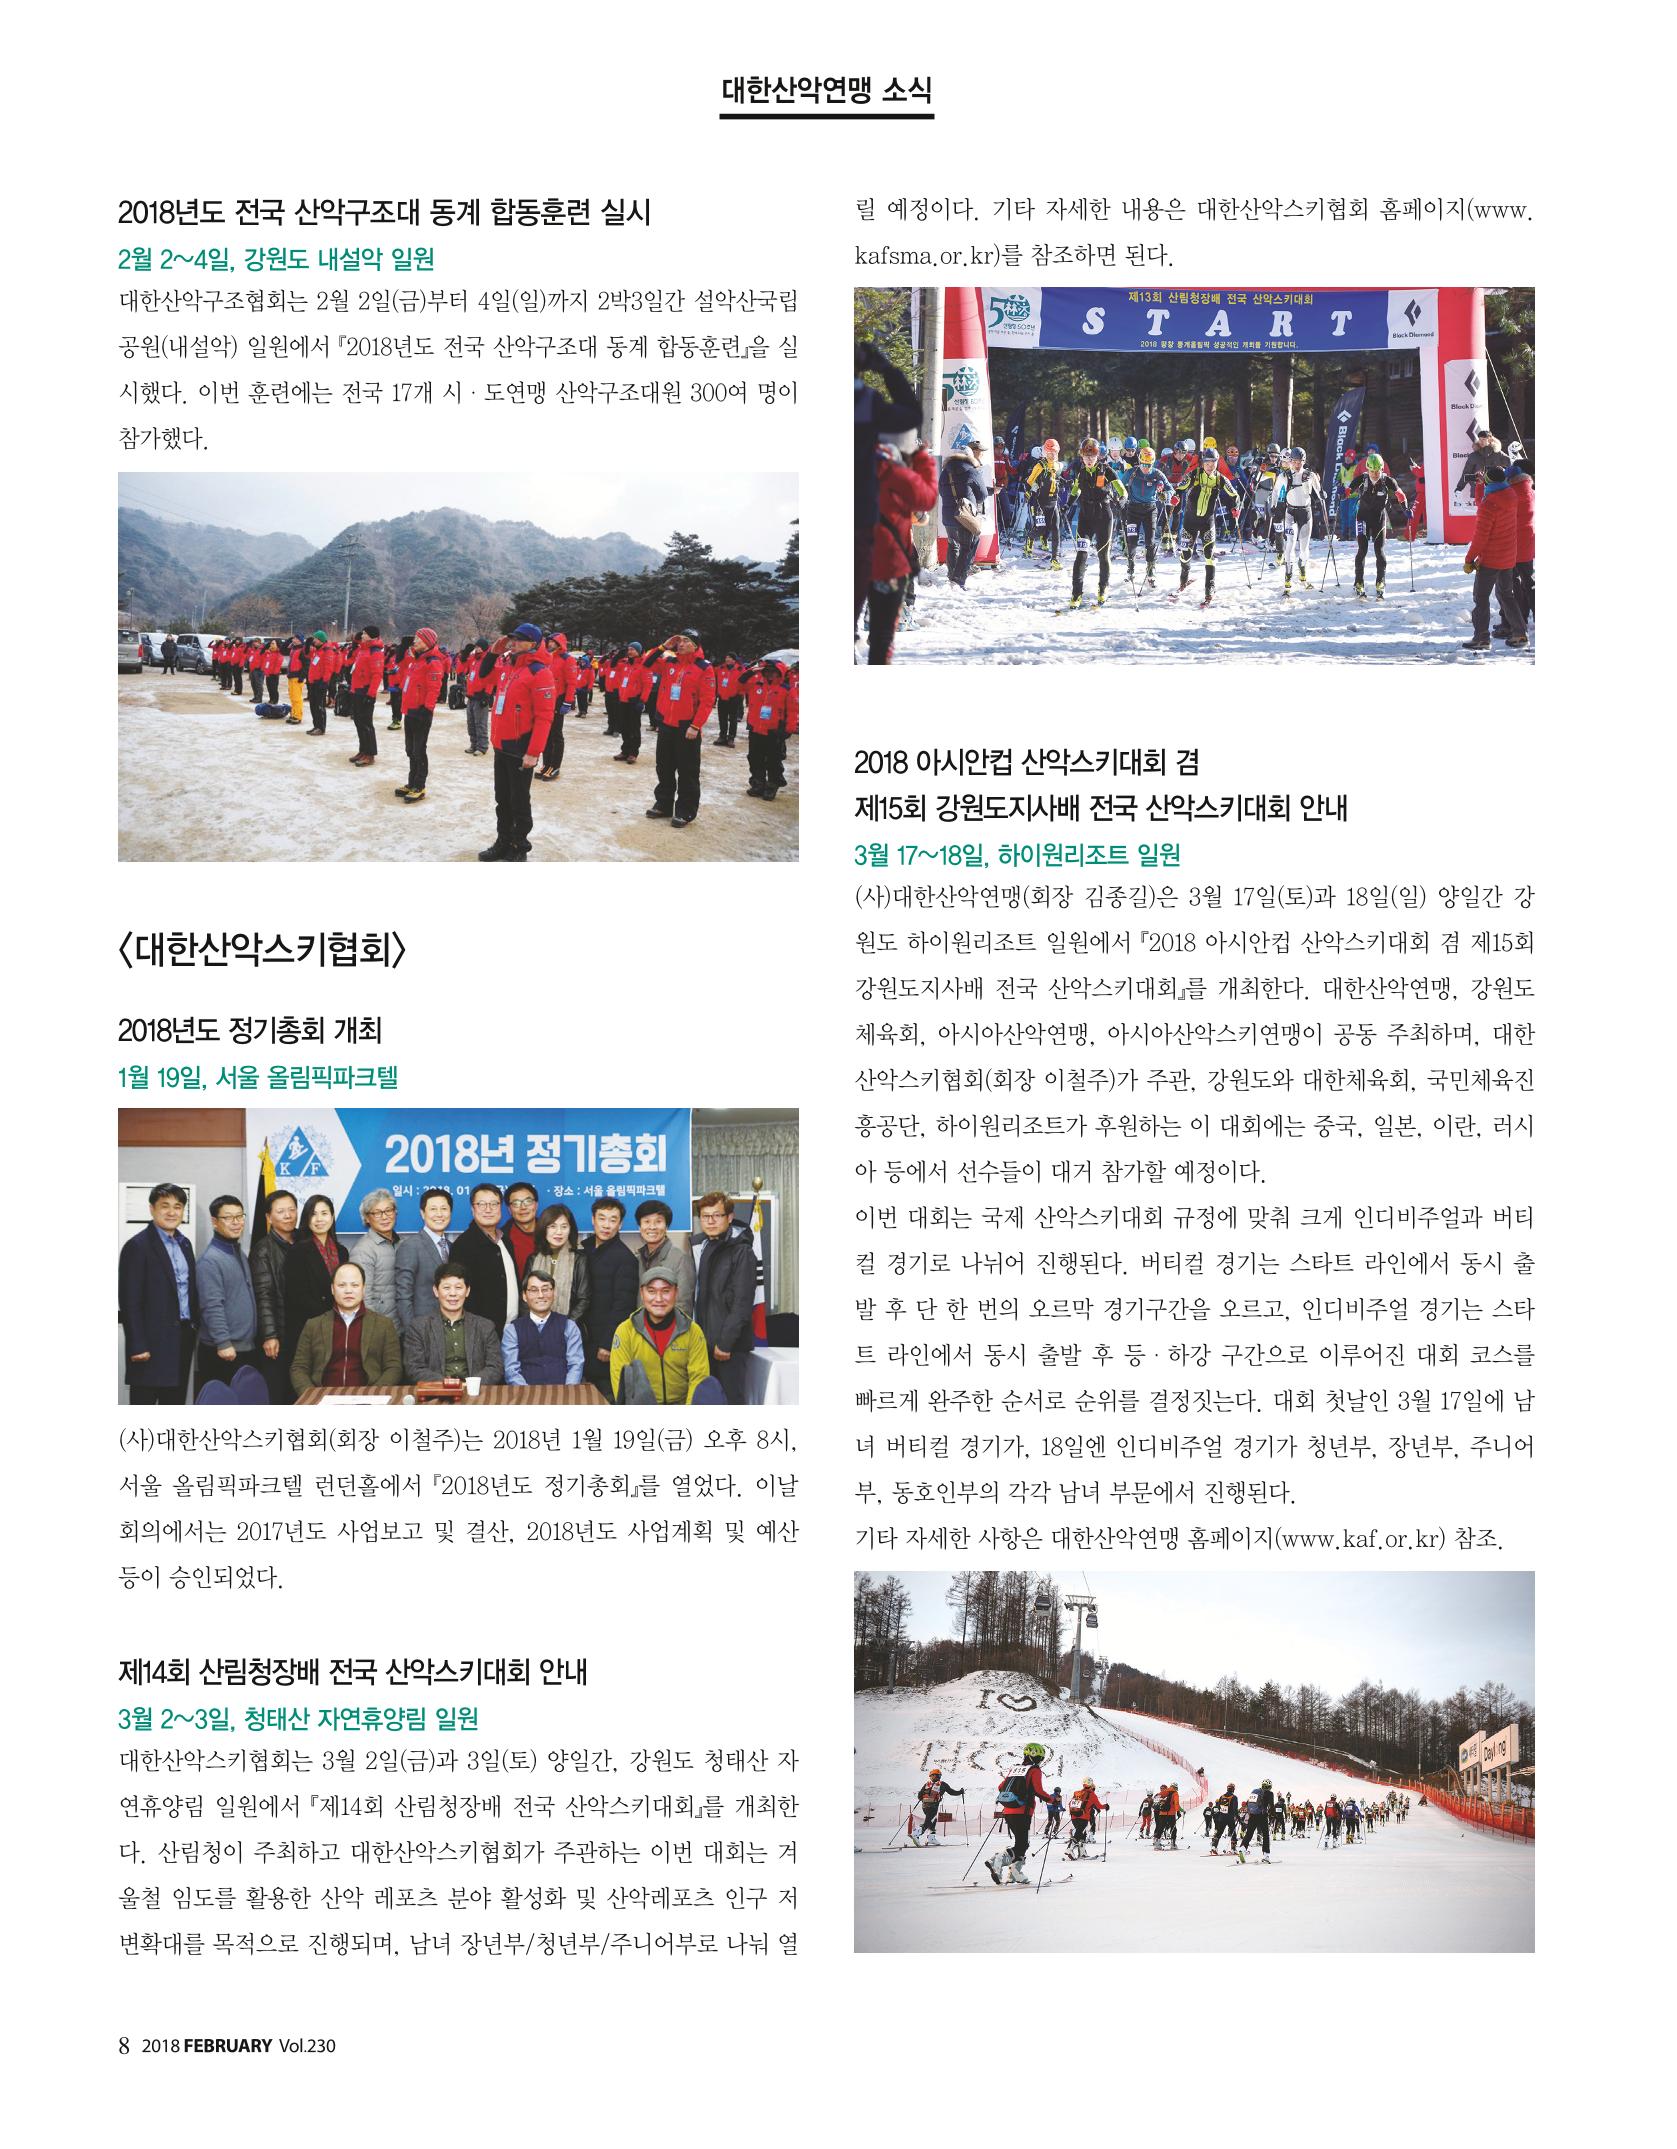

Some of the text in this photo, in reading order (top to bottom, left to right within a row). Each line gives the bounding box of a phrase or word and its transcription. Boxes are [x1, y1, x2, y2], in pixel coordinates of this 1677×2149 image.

[722, 75, 932, 105] 대한산악연맹 소식
[117, 197, 650, 227] 2018년도 전국 산악구조대 동계 합동훈련 실시
[856, 197, 1532, 222] 릴 예정이다. 기타 자세한 내용은 대한산악스키협회 홈페이지(www.
[117, 246, 152, 272] 2월
[244, 246, 310, 273] 강원도
[318, 247, 384, 272] 내설악
[391, 246, 434, 272] 일원
[854, 242, 1173, 268] kafsma.or.kr)를 참조하면 된다.
[119, 288, 797, 314] 대한산악구조협회는 2월 2일(금)부터 4일(일)까지 2박3일간 설악산국립
[1128, 291, 1314, 305] 제13회 산림청장배 전국 산악스키대회
[1082, 306, 1353, 338] START
[119, 426, 208, 451] 참가했다.
[1335, 425, 1348, 460] Black
[854, 747, 1199, 777] 2018 아시안컵 산악스키대회 겸
[854, 793, 1348, 823] 제15회 강원도지사배 전국 산악스키대회 안내
[854, 842, 889, 868] 3월
[997, 842, 1130, 868] 하이원리조트
[1137, 842, 1181, 868] 일원
[855, 884, 1536, 910] (사)대한산악연맹(회장 김종길)은 3월 17일(토)과 18일(일) 양일간 강
[117, 1015, 382, 1045] 2018년도 정기총회 개최
[855, 1022, 1536, 1048] 체육회, 아시아산악연맹, 아시아산악스키연맹이 공동 주최하며, 대한
[118, 1064, 398, 1092] 1월 19일, 서울 올림픽파크텔
[385, 1132, 668, 1175] 2018년 정기총회
[855, 1159, 1266, 1185] 아 등에서 선수들이 대거 참가할 예정이다.
[392, 1184, 413, 1198] 일시
[553, 1184, 575, 1198] 장소
[583, 1184, 605, 1198] 서울
[606, 1184, 666, 1198] 올림픽파크텔
[855, 1388, 1536, 1414] 빠르게 완주한 순서로 순위를 결정짓는다. 대회 첫날인 3월 17일에 남
[119, 1427, 796, 1453] (사)대한산악스키협회(회장 이철주)는 2018년 1월 19일(금) 오후 8시,
[856, 1526, 1503, 1551] 기타 자세한 사항은 대한산악연맹 홈페이지(www.kaf.or.kr) 참조.
[117, 1565, 283, 1590] 등이 승인되었다.
[118, 1657, 587, 1687] 제14회 산림청장배 전국 산악스키대회 안내
[117, 1706, 153, 1732] 3월
[244, 1706, 311, 1732] 청태산
[317, 1706, 426, 1732] 자연휴양림
[435, 1706, 479, 1732] 일원
[119, 1748, 800, 1774] 대한산악스키협회는 3월 2일(금)과 3일(토) 양일간, 강원도 청태산 자
[118, 2036, 336, 2055] 8 2018 FEBRUARY Vol.230
